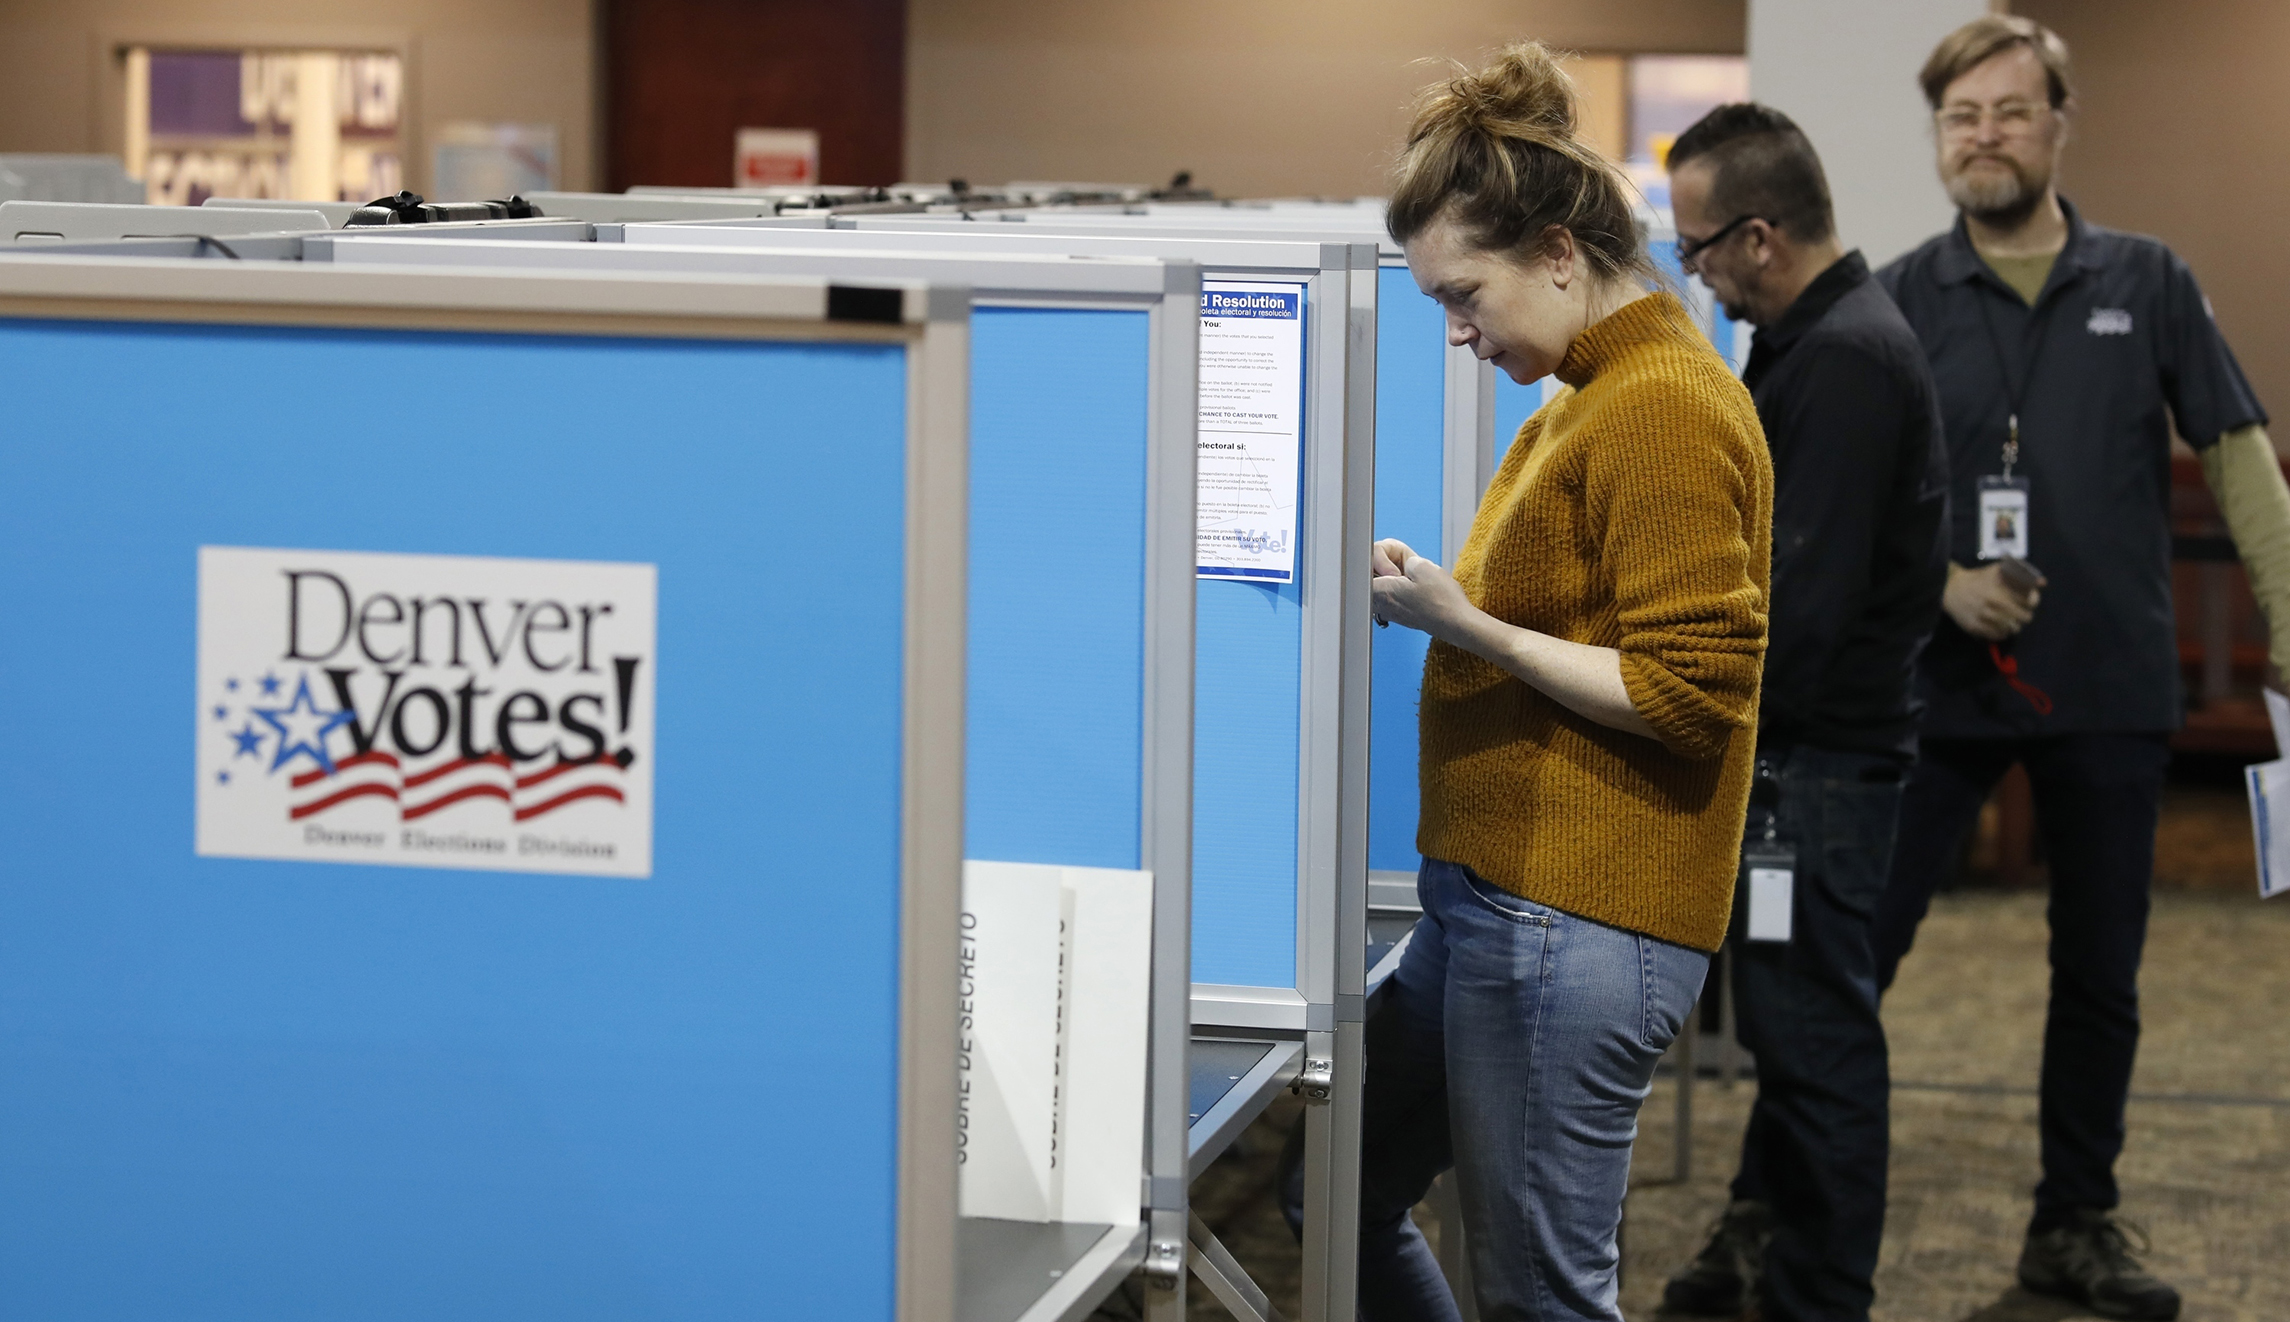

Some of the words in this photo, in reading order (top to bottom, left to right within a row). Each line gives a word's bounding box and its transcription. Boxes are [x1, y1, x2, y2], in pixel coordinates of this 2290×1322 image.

[1212, 294, 1285, 309] Resolution
[1203, 320, 1221, 328] You:
[1197, 442, 1235, 450] electoral
[1234, 528, 1288, 554] Vote!
[278, 569, 614, 674] Denver
[322, 654, 644, 770] Votes!
[303, 824, 386, 848] Denver
[399, 830, 507, 855] Elections
[516, 834, 618, 859] Division
[959, 911, 977, 1030] SECRETO
